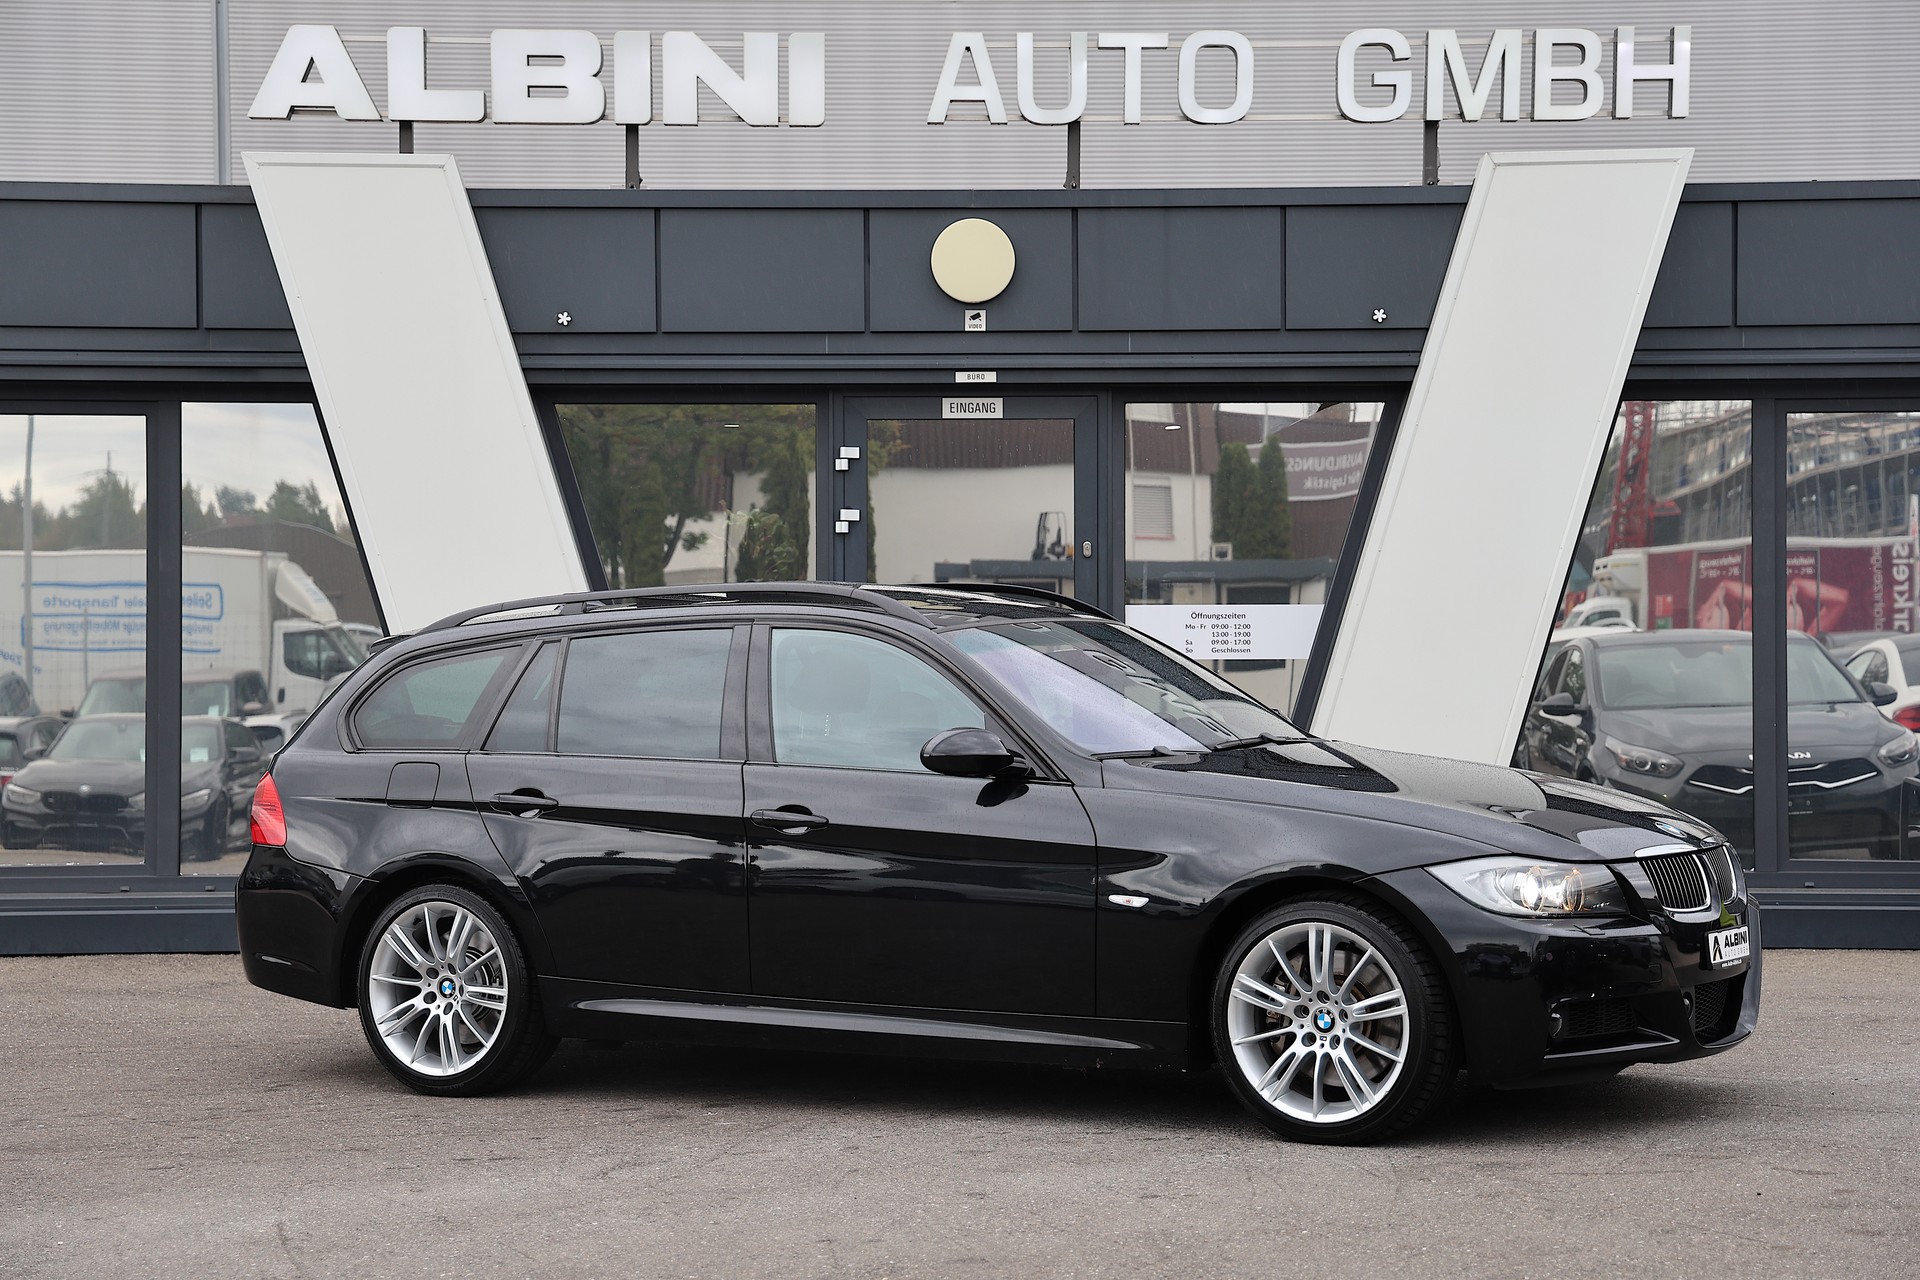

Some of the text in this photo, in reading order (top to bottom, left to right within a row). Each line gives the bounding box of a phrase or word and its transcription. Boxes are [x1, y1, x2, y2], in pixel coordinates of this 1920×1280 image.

[248, 24, 1692, 128] ALBINI AUTO GMBH
[949, 402, 996, 413] EINGANG
[1191, 611, 1246, 620] Öffnungszeiten
[1724, 930, 1748, 948] ALBINI
